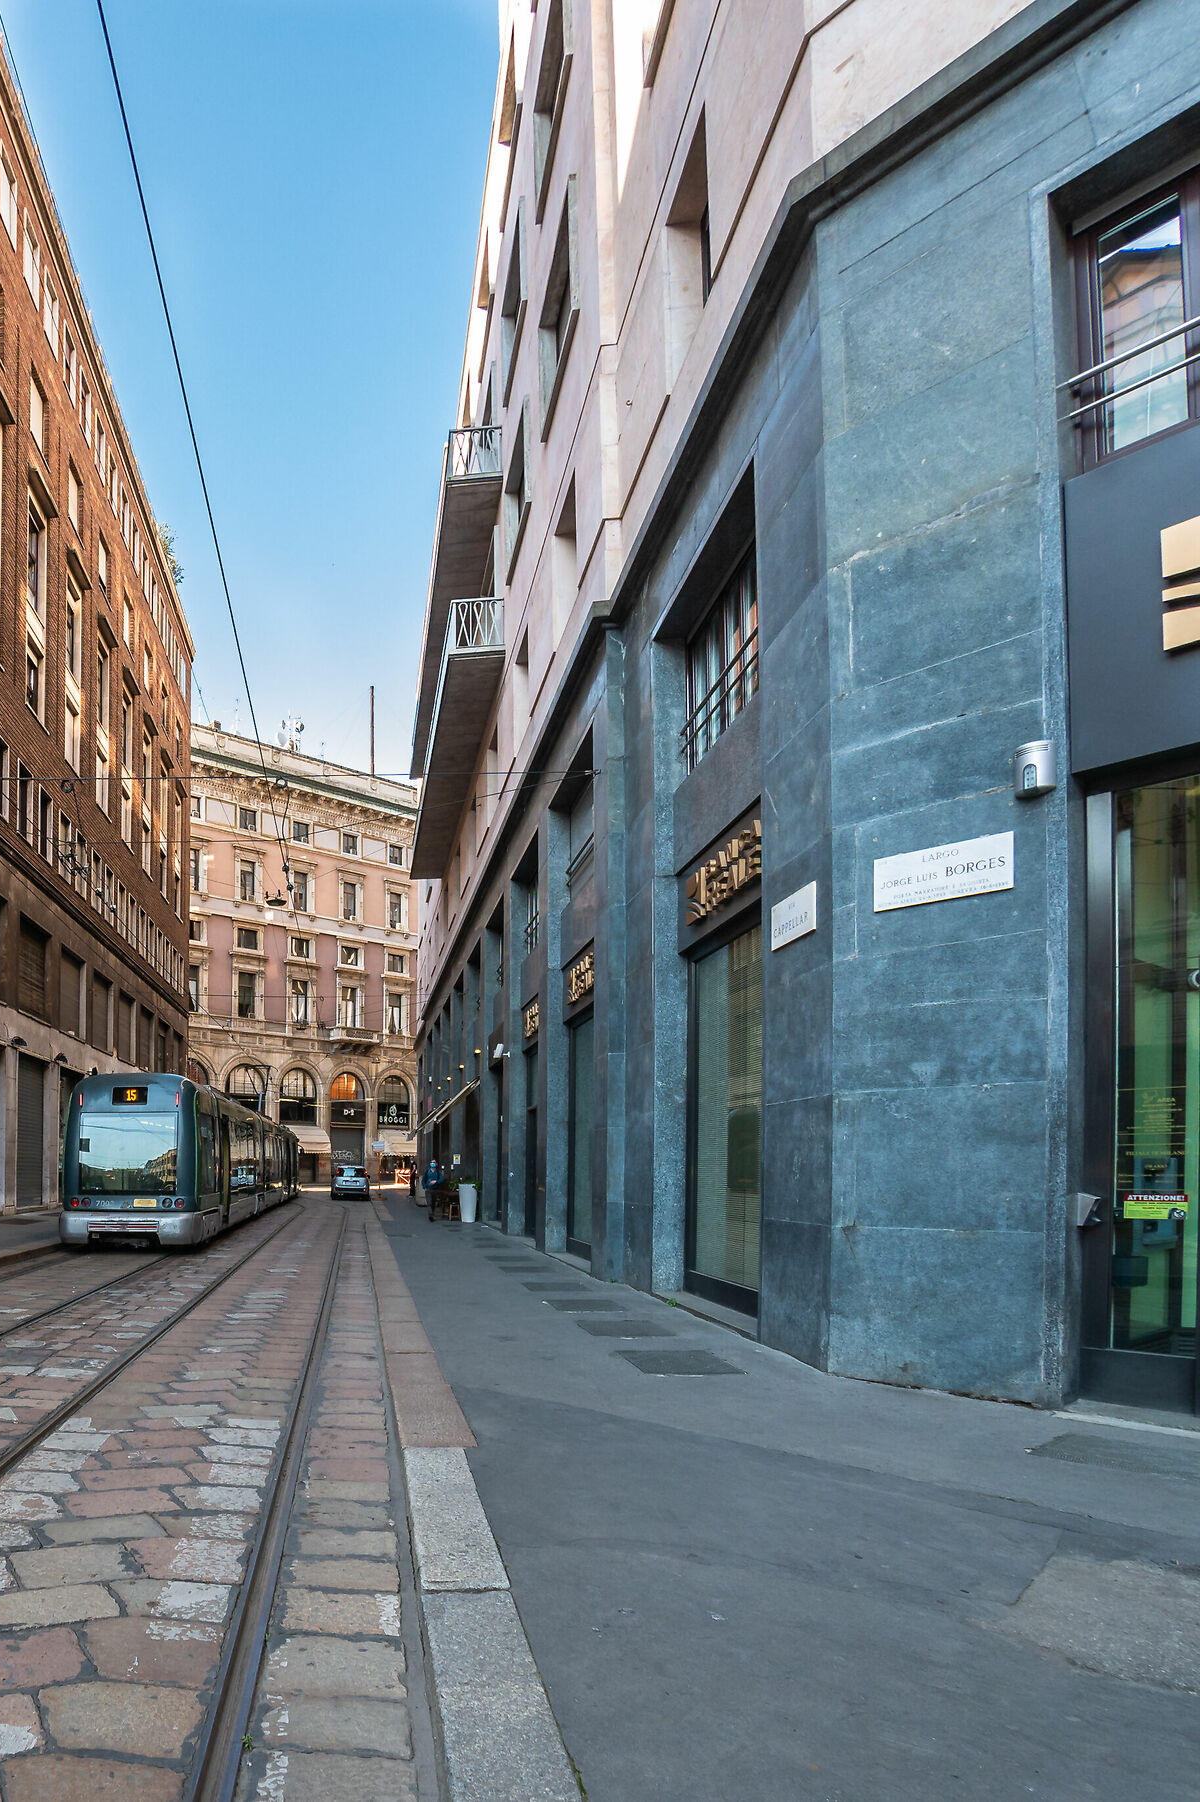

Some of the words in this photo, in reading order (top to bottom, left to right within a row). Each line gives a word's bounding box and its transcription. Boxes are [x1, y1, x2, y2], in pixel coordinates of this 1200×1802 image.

[922, 848, 959, 863] LARGO
[880, 876, 912, 890] JORGE
[916, 872, 938, 883] LUIS
[945, 856, 1006, 877] BORGES
[126, 1089, 137, 1102] 15
[379, 1115, 407, 1124] BROGGI
[1127, 1194, 1185, 1202] ATTENZIONE!
